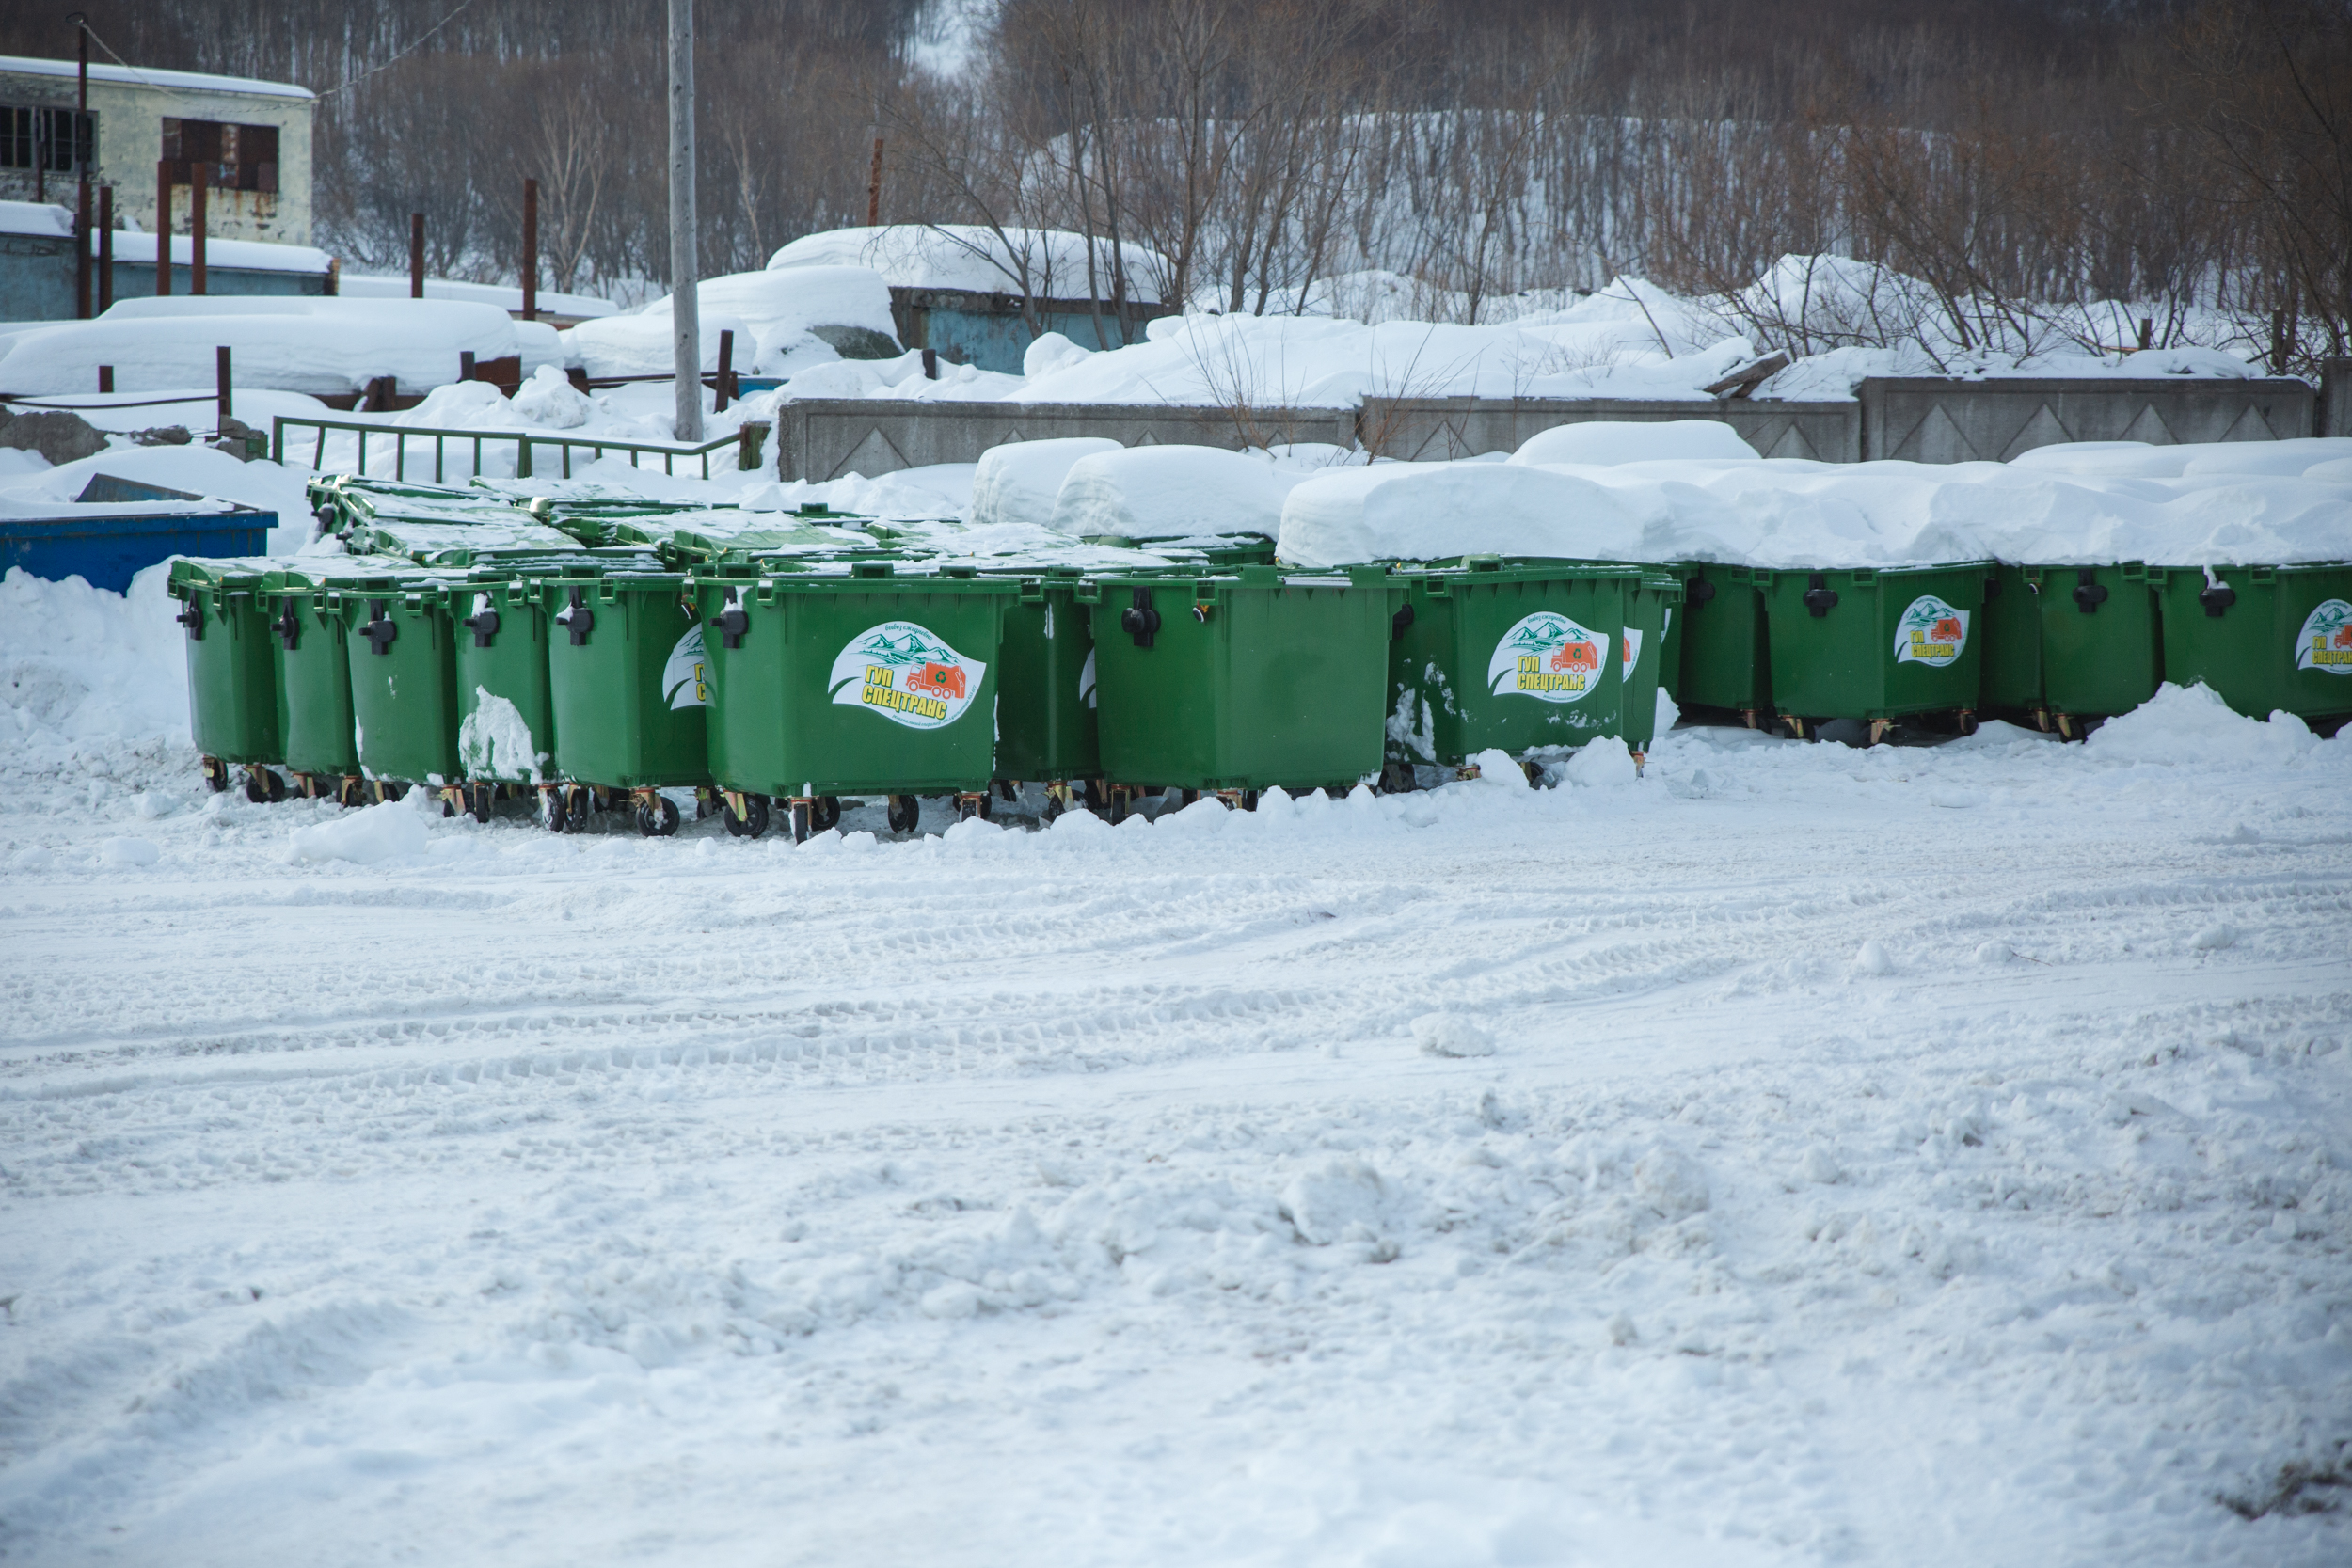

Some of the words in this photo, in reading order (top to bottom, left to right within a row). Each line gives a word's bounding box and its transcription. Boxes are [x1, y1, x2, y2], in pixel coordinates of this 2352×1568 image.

[1910, 630, 1925, 643] ГУП
[2312, 635, 2328, 650] ГУП
[1911, 643, 1955, 659] СПЕЦТРАНС
[1518, 656, 1540, 673] ГУП
[865, 664, 894, 688] ГУП
[1517, 673, 1586, 692] СПЕЦТРАНС
[862, 684, 948, 721] СПЕЦТРАНС
